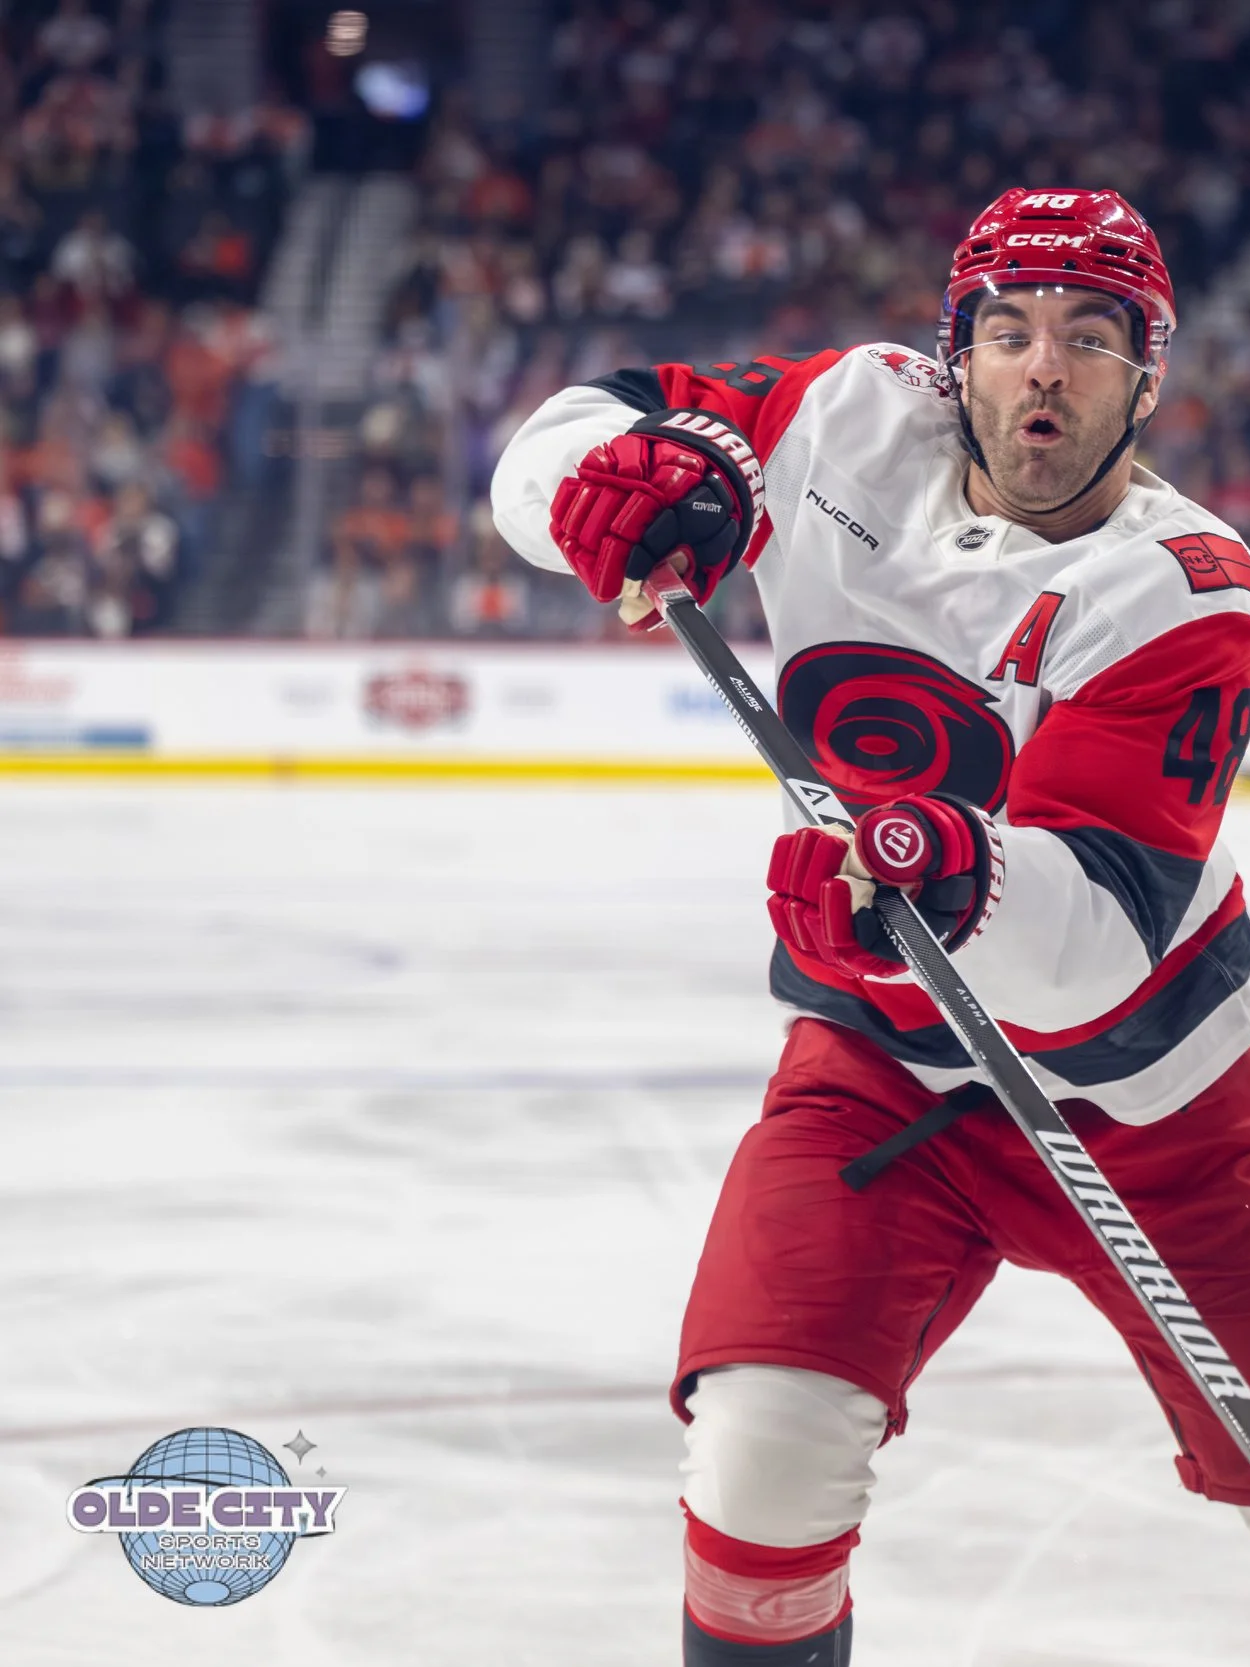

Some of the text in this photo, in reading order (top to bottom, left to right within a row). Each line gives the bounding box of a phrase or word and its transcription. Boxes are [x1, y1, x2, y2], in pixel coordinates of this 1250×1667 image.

[1006, 233, 1086, 248] CCM
[692, 501, 723, 513] COVERT
[805, 488, 880, 552] NUCOR
[985, 590, 1066, 688] A
[706, 672, 760, 746] WARRIOR
[956, 987, 988, 1027] ALPHA
